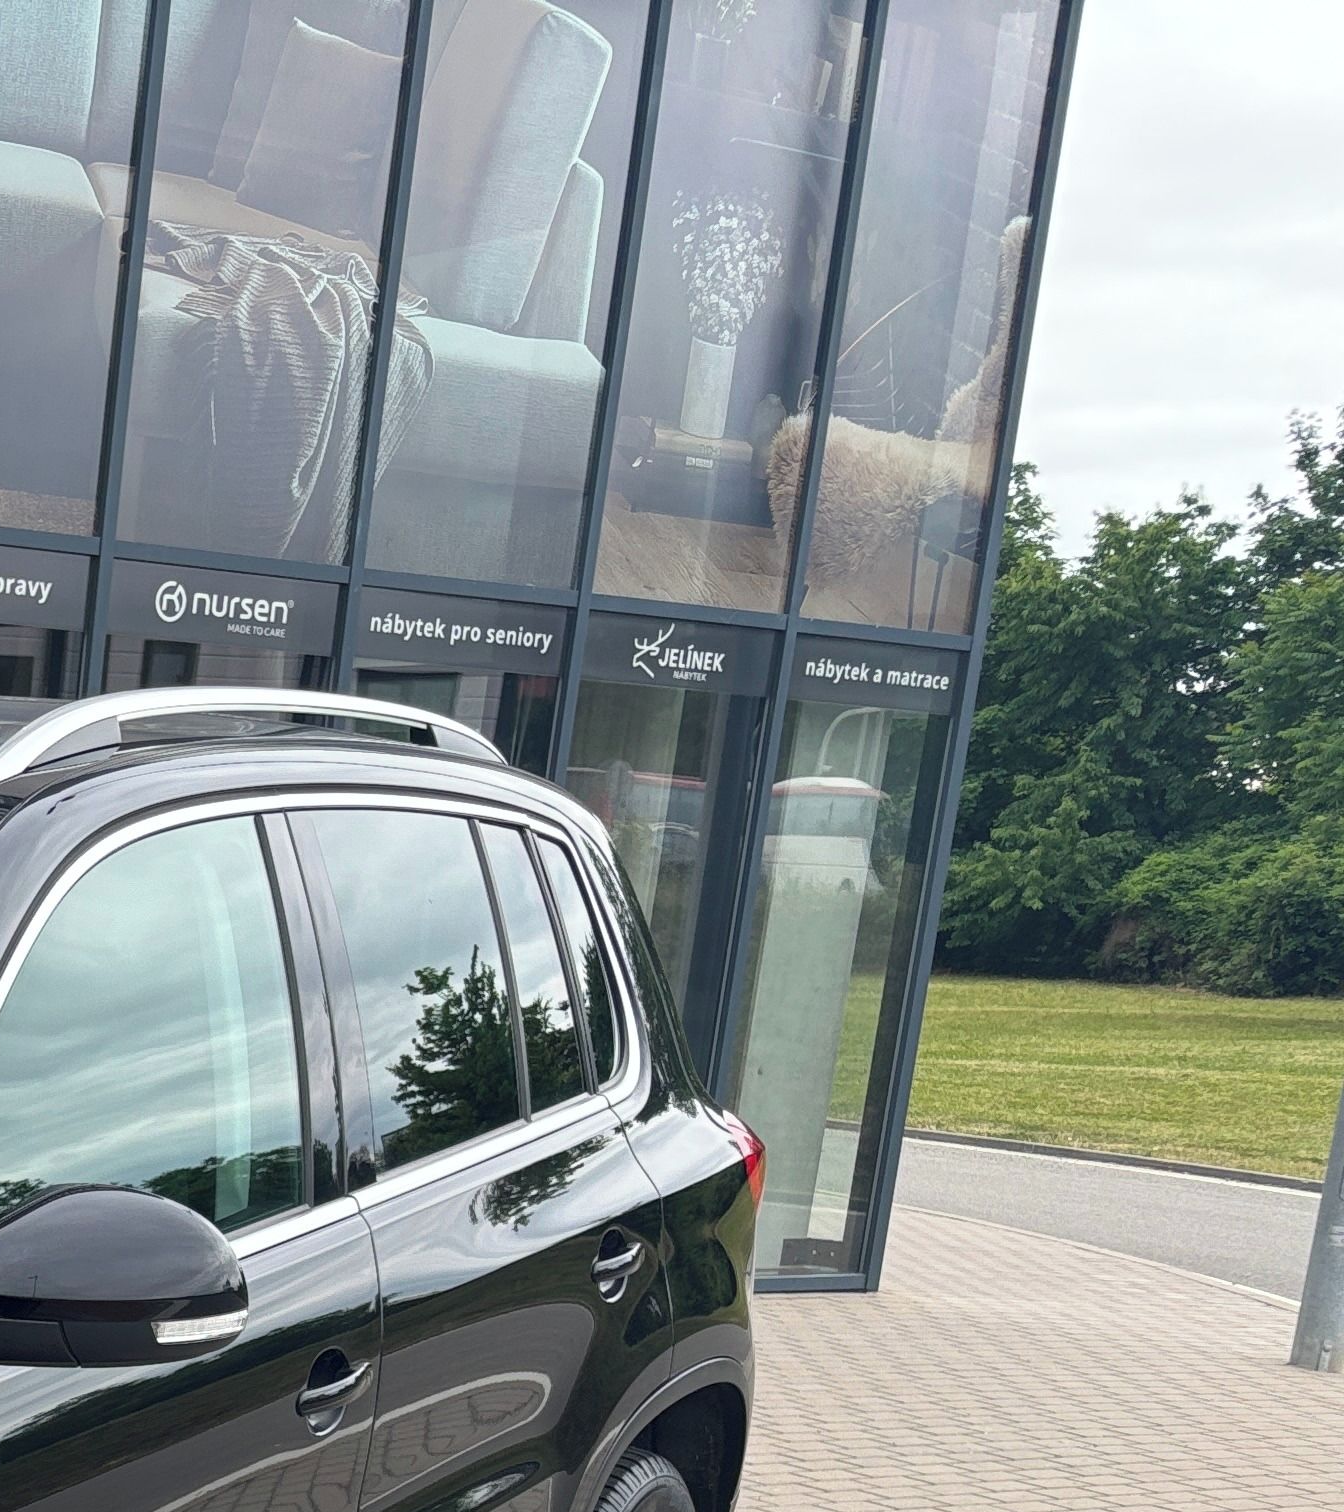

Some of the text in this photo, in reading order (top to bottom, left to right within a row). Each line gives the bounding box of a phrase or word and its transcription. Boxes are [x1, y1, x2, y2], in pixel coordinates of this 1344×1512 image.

[192, 592, 289, 624] nursen
[227, 623, 286, 638] MADE TO CARE
[370, 613, 553, 654] nábytek pro seniory
[657, 644, 725, 674] JELÍNEK
[805, 658, 949, 691] nábytek a matrace
